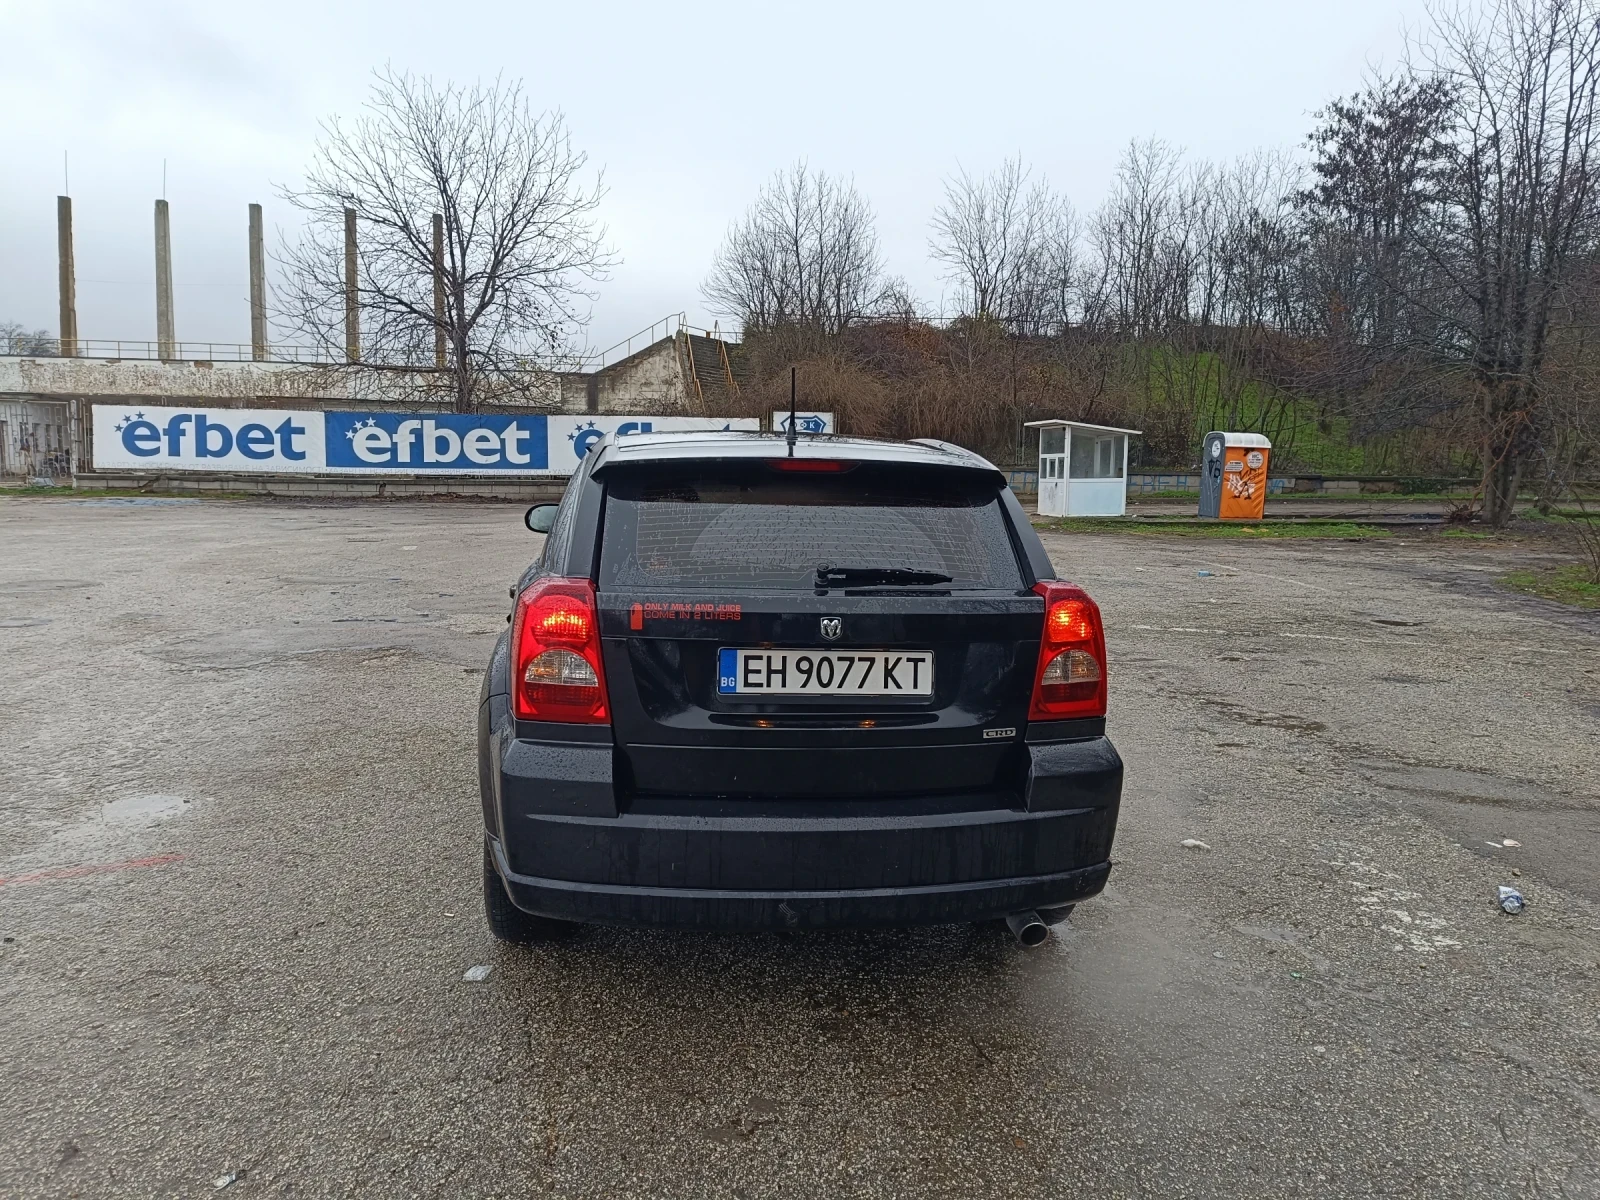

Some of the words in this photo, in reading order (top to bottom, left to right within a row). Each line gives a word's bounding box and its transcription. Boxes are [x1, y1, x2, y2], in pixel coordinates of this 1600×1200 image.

[121, 413, 306, 461] efbet
[352, 419, 531, 464] efbet
[644, 602, 669, 611] ONLY
[671, 603, 692, 611] MILK
[694, 603, 714, 612] AND
[716, 604, 741, 612] JUICE
[644, 610, 676, 619] COME
[679, 611, 690, 619] IN
[704, 611, 741, 620] LITERS
[743, 655, 788, 688] EH
[795, 655, 876, 689] 9077
[883, 656, 926, 690] KT
[720, 676, 736, 687] BG
[985, 729, 1014, 737] CRD
